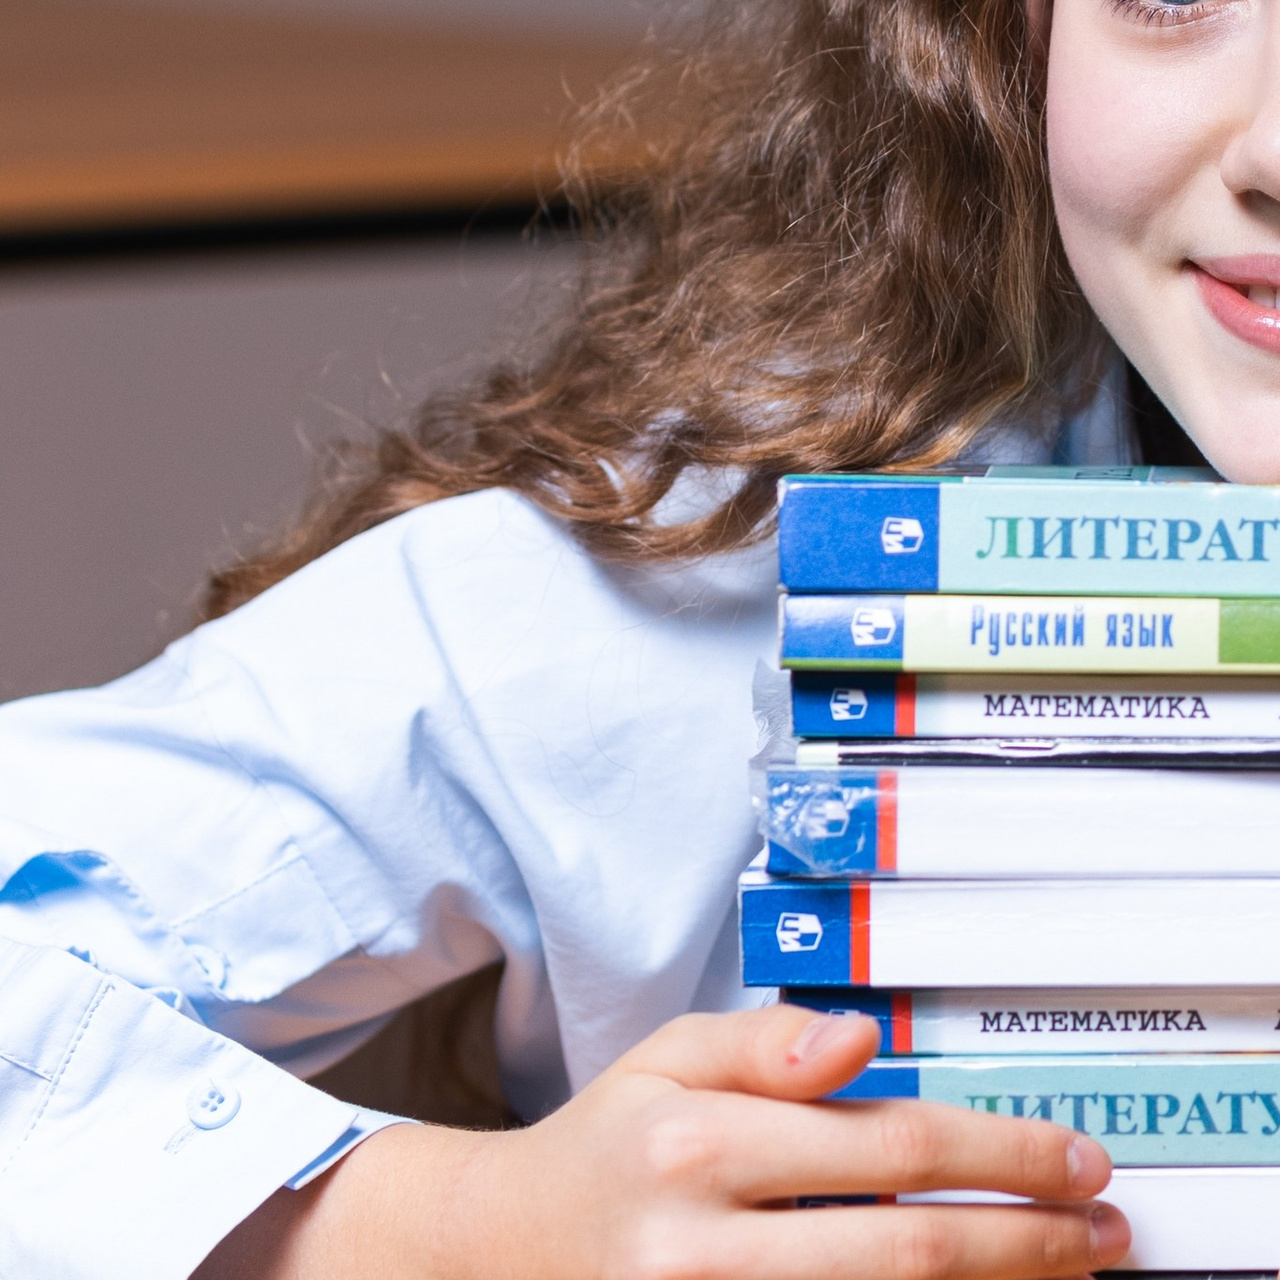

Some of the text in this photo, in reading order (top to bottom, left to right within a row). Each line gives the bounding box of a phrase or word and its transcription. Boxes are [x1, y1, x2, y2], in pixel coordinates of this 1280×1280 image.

[970, 604, 1174, 656] Русский язык
[983, 693, 1211, 720] МАТЕМАТИКА
[979, 1008, 1208, 1033] МАТЕМАТИКА
